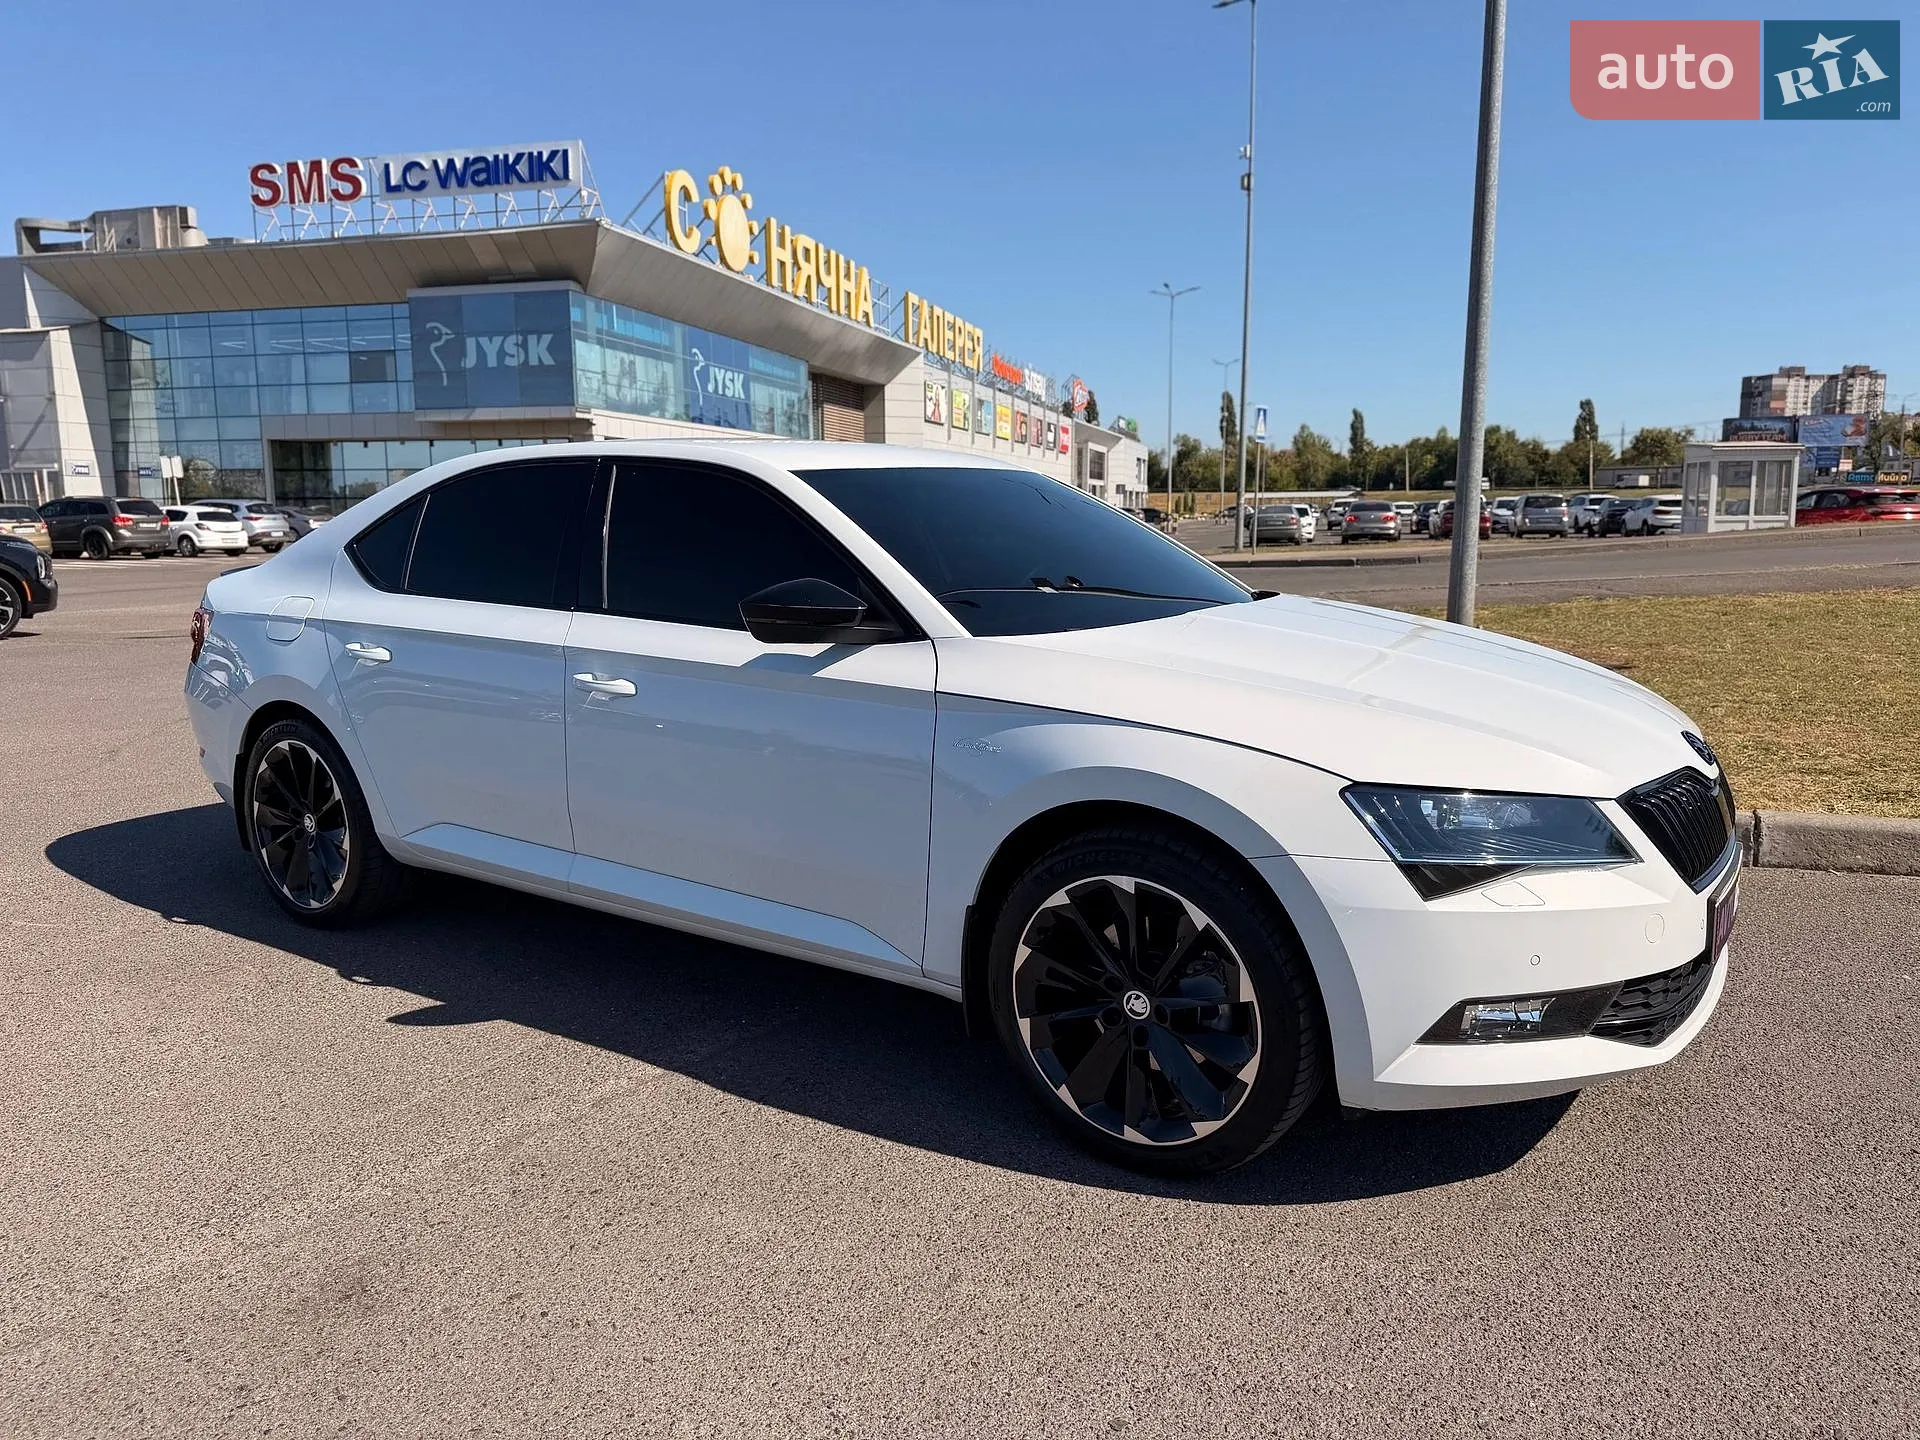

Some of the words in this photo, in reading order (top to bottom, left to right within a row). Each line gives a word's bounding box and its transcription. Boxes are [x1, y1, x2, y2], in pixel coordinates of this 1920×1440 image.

[249, 156, 366, 207] SMS
[384, 160, 429, 193] LC
[903, 290, 984, 373] ГАЛЕРЕЯ
[461, 334, 556, 369] JYSK
[707, 366, 746, 399] JYSK
